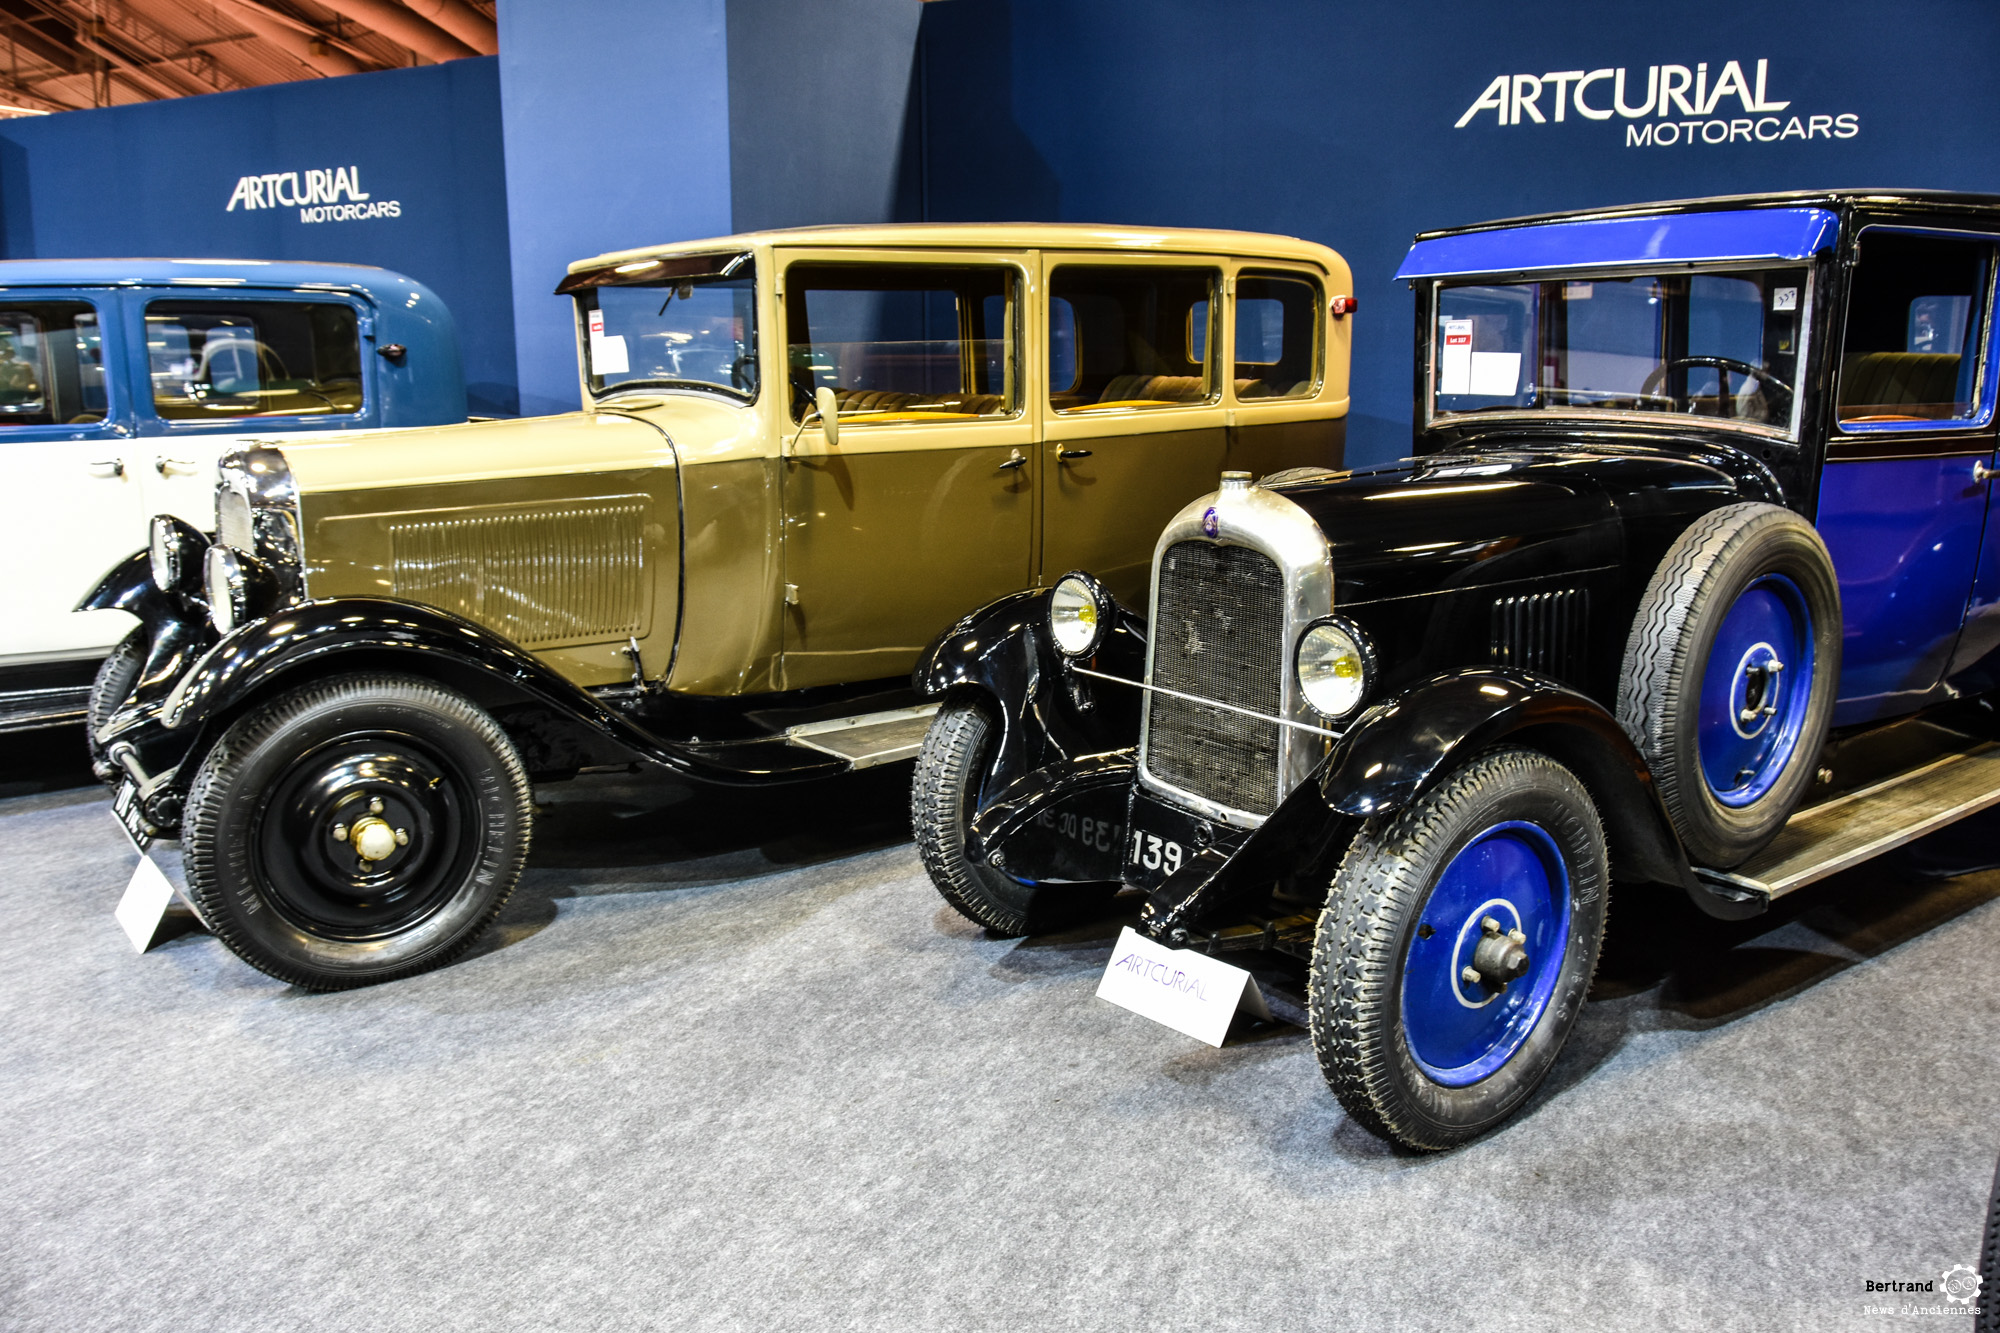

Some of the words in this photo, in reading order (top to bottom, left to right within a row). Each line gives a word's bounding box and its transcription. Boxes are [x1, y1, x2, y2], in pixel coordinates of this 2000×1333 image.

[1454, 58, 1791, 129] ARTCURIAL
[1626, 113, 1860, 148] MOTORCARS
[226, 165, 370, 212] ARTCURIAL
[300, 200, 401, 224] MOTORCARS
[1132, 830, 1183, 877] 139
[1115, 953, 1208, 1002] ARTCURIAL
